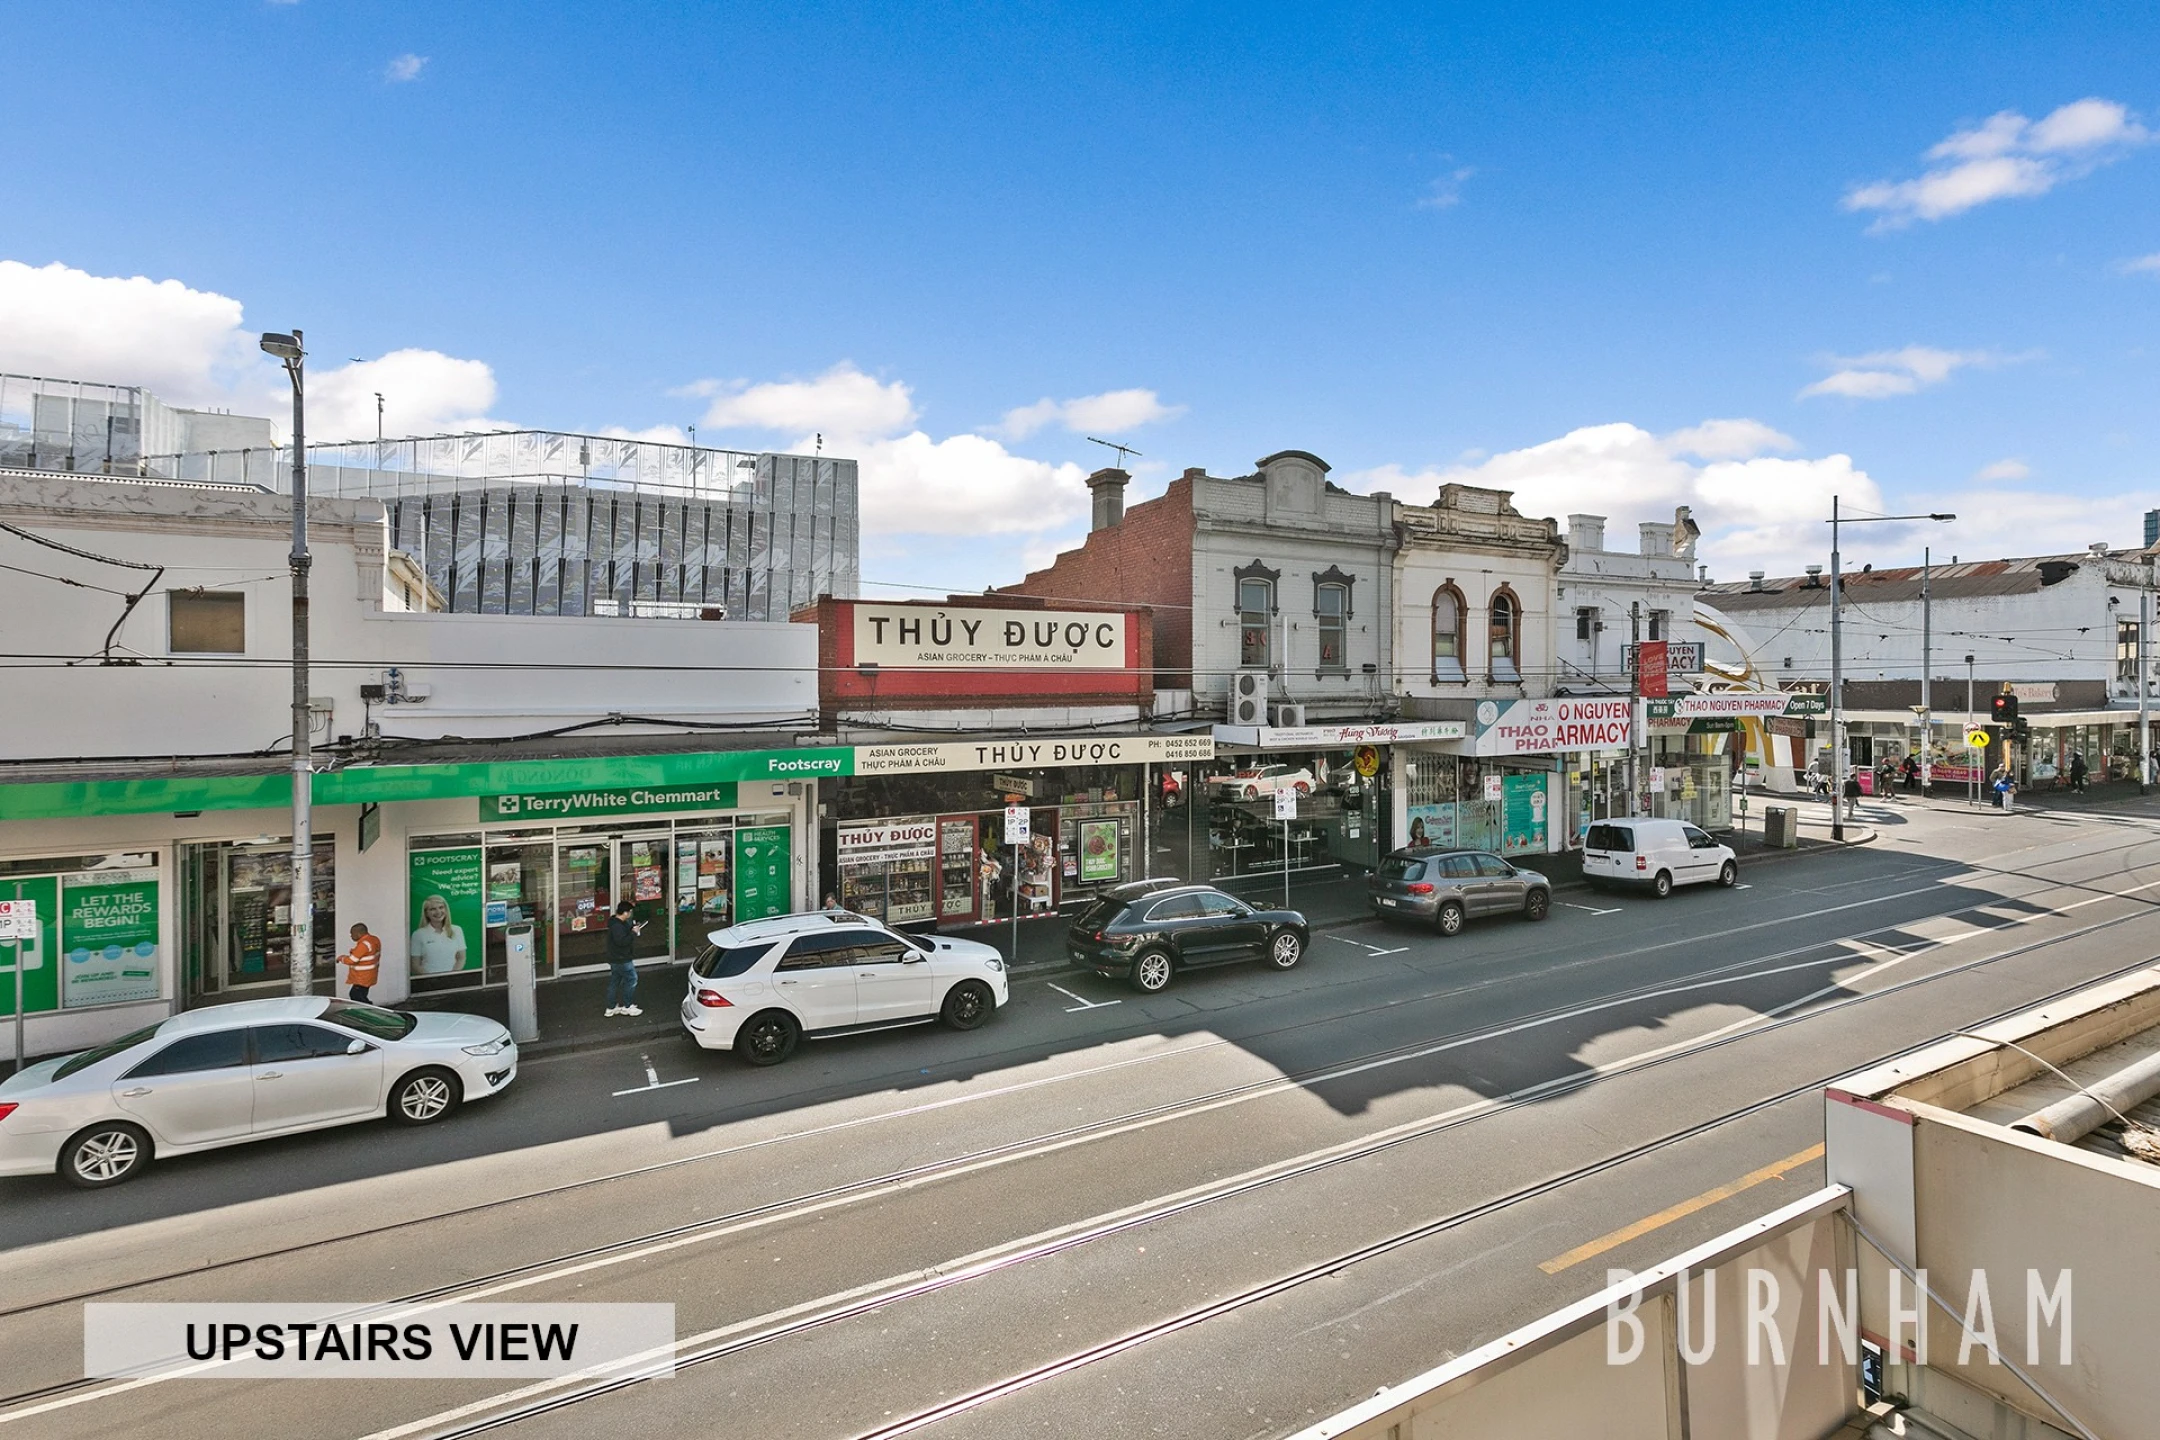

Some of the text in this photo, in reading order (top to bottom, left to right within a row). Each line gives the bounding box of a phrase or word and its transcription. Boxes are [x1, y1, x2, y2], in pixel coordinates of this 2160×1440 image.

[868, 612, 1114, 654] THỦY ĐƯỢC
[917, 653, 944, 661] ASIAN
[946, 653, 987, 661] GROCERY
[1574, 702, 1630, 720] NGUYEN
[1685, 699, 1786, 711] THAO NGUYEN PHARMACY
[1789, 700, 1825, 711] Open 7 Days
[1648, 717, 1691, 728] PHARMACY
[1498, 725, 1549, 738] THAO
[1148, 740, 1161, 748] PH:
[869, 747, 938, 757] ASIAN GROCERY
[975, 742, 1121, 763] THỦY ĐƯỢC
[1165, 750, 1183, 758] 0416
[768, 758, 842, 772] Footscray
[523, 788, 721, 812] TerryWhite Chemmart
[839, 828, 933, 845] THỦY ĐƯỢC
[427, 854, 478, 864] FOOTSCRAY
[455, 867, 478, 875] expert
[451, 874, 478, 882] advice?
[81, 892, 144, 907] LET THE
[72, 902, 152, 918] REWARDS
[84, 915, 140, 928] BEGIN!
